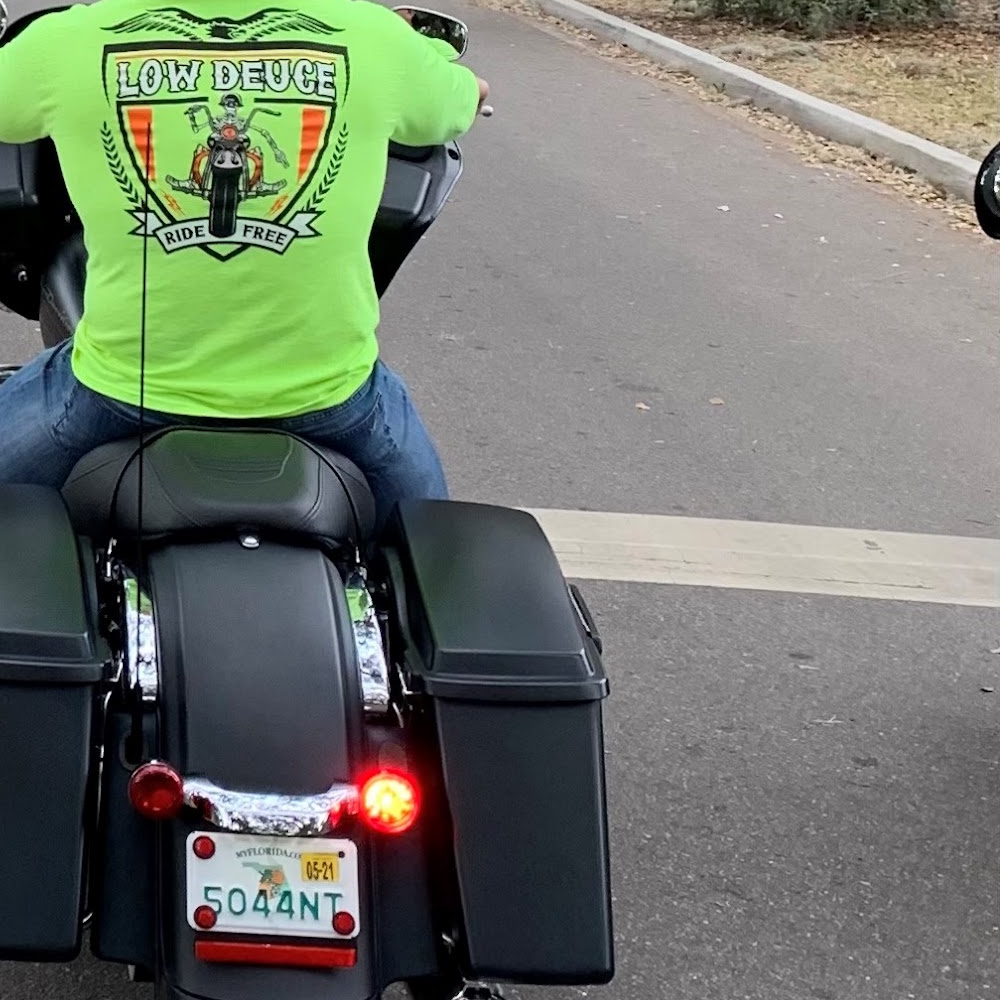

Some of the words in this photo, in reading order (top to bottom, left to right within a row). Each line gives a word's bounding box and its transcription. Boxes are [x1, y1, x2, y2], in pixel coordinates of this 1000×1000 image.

[117, 59, 204, 98] LOW
[211, 59, 337, 99] DEUCE
[164, 225, 206, 245] RIDE
[243, 225, 288, 246] FREE
[236, 847, 302, 860] MYFLORIDA.CO
[306, 861, 335, 881] 05-21
[203, 886, 343, 921] 5044NT
